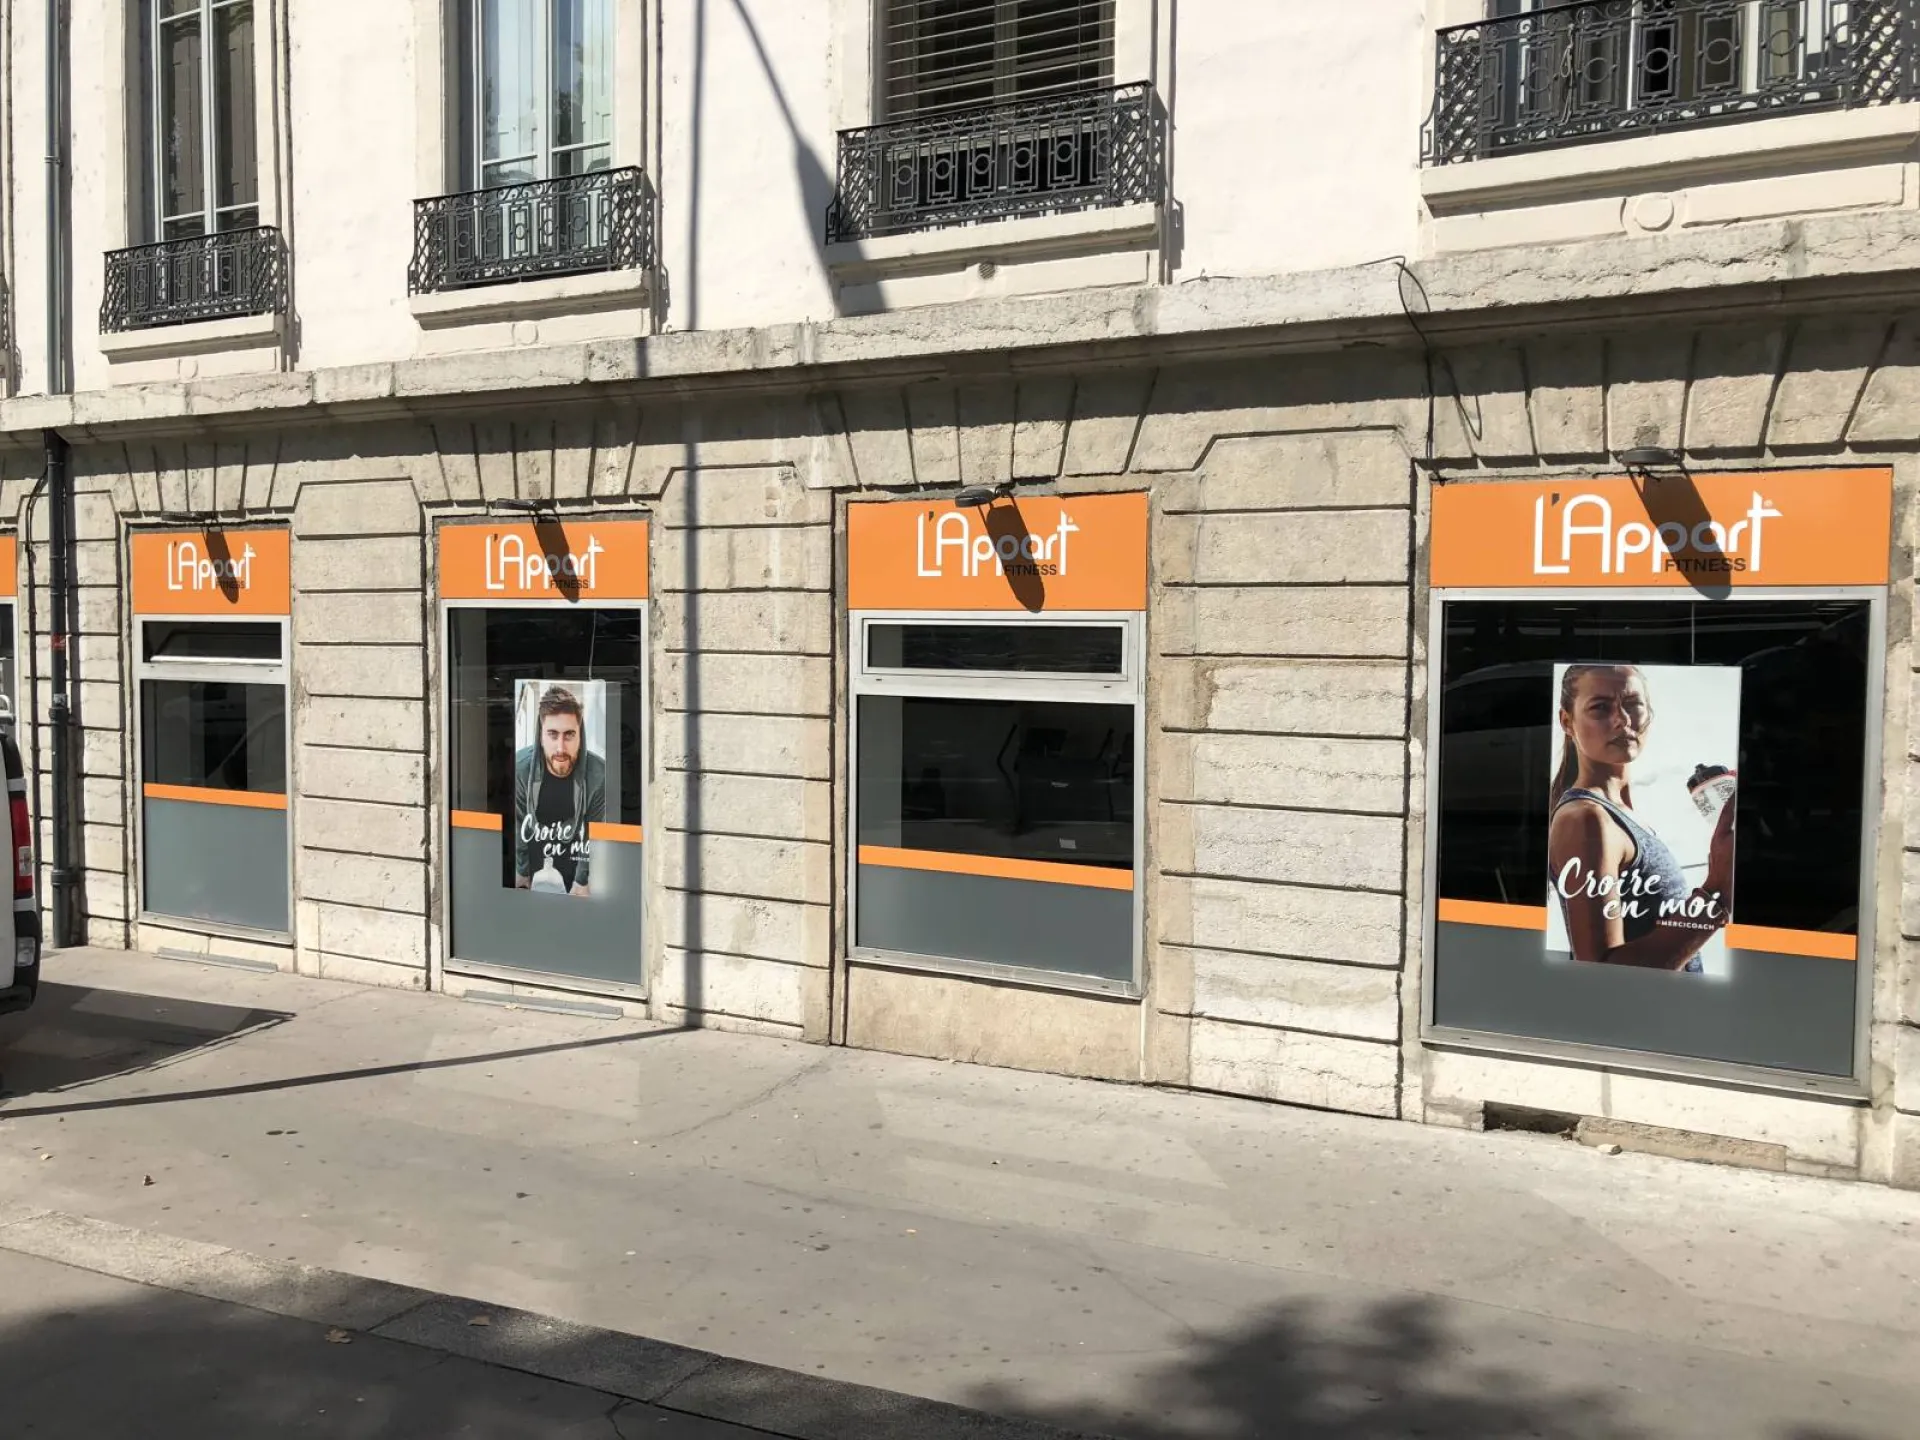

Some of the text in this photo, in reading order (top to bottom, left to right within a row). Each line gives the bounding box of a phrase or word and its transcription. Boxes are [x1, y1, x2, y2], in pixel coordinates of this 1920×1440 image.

[917, 509, 1080, 576] L'Appart
[1533, 490, 1783, 574] L'Appart
[168, 541, 257, 590] L'Appart
[485, 533, 605, 589] L'Appart
[1004, 564, 1057, 576] FITNESS
[1665, 557, 1746, 572] FITNESS
[216, 580, 246, 589] FIESS
[550, 579, 589, 589] FITNESS
[521, 813, 574, 842] Croire
[543, 842, 567, 857] en
[1557, 857, 1664, 899] Croire
[1602, 892, 1722, 920] en moi
